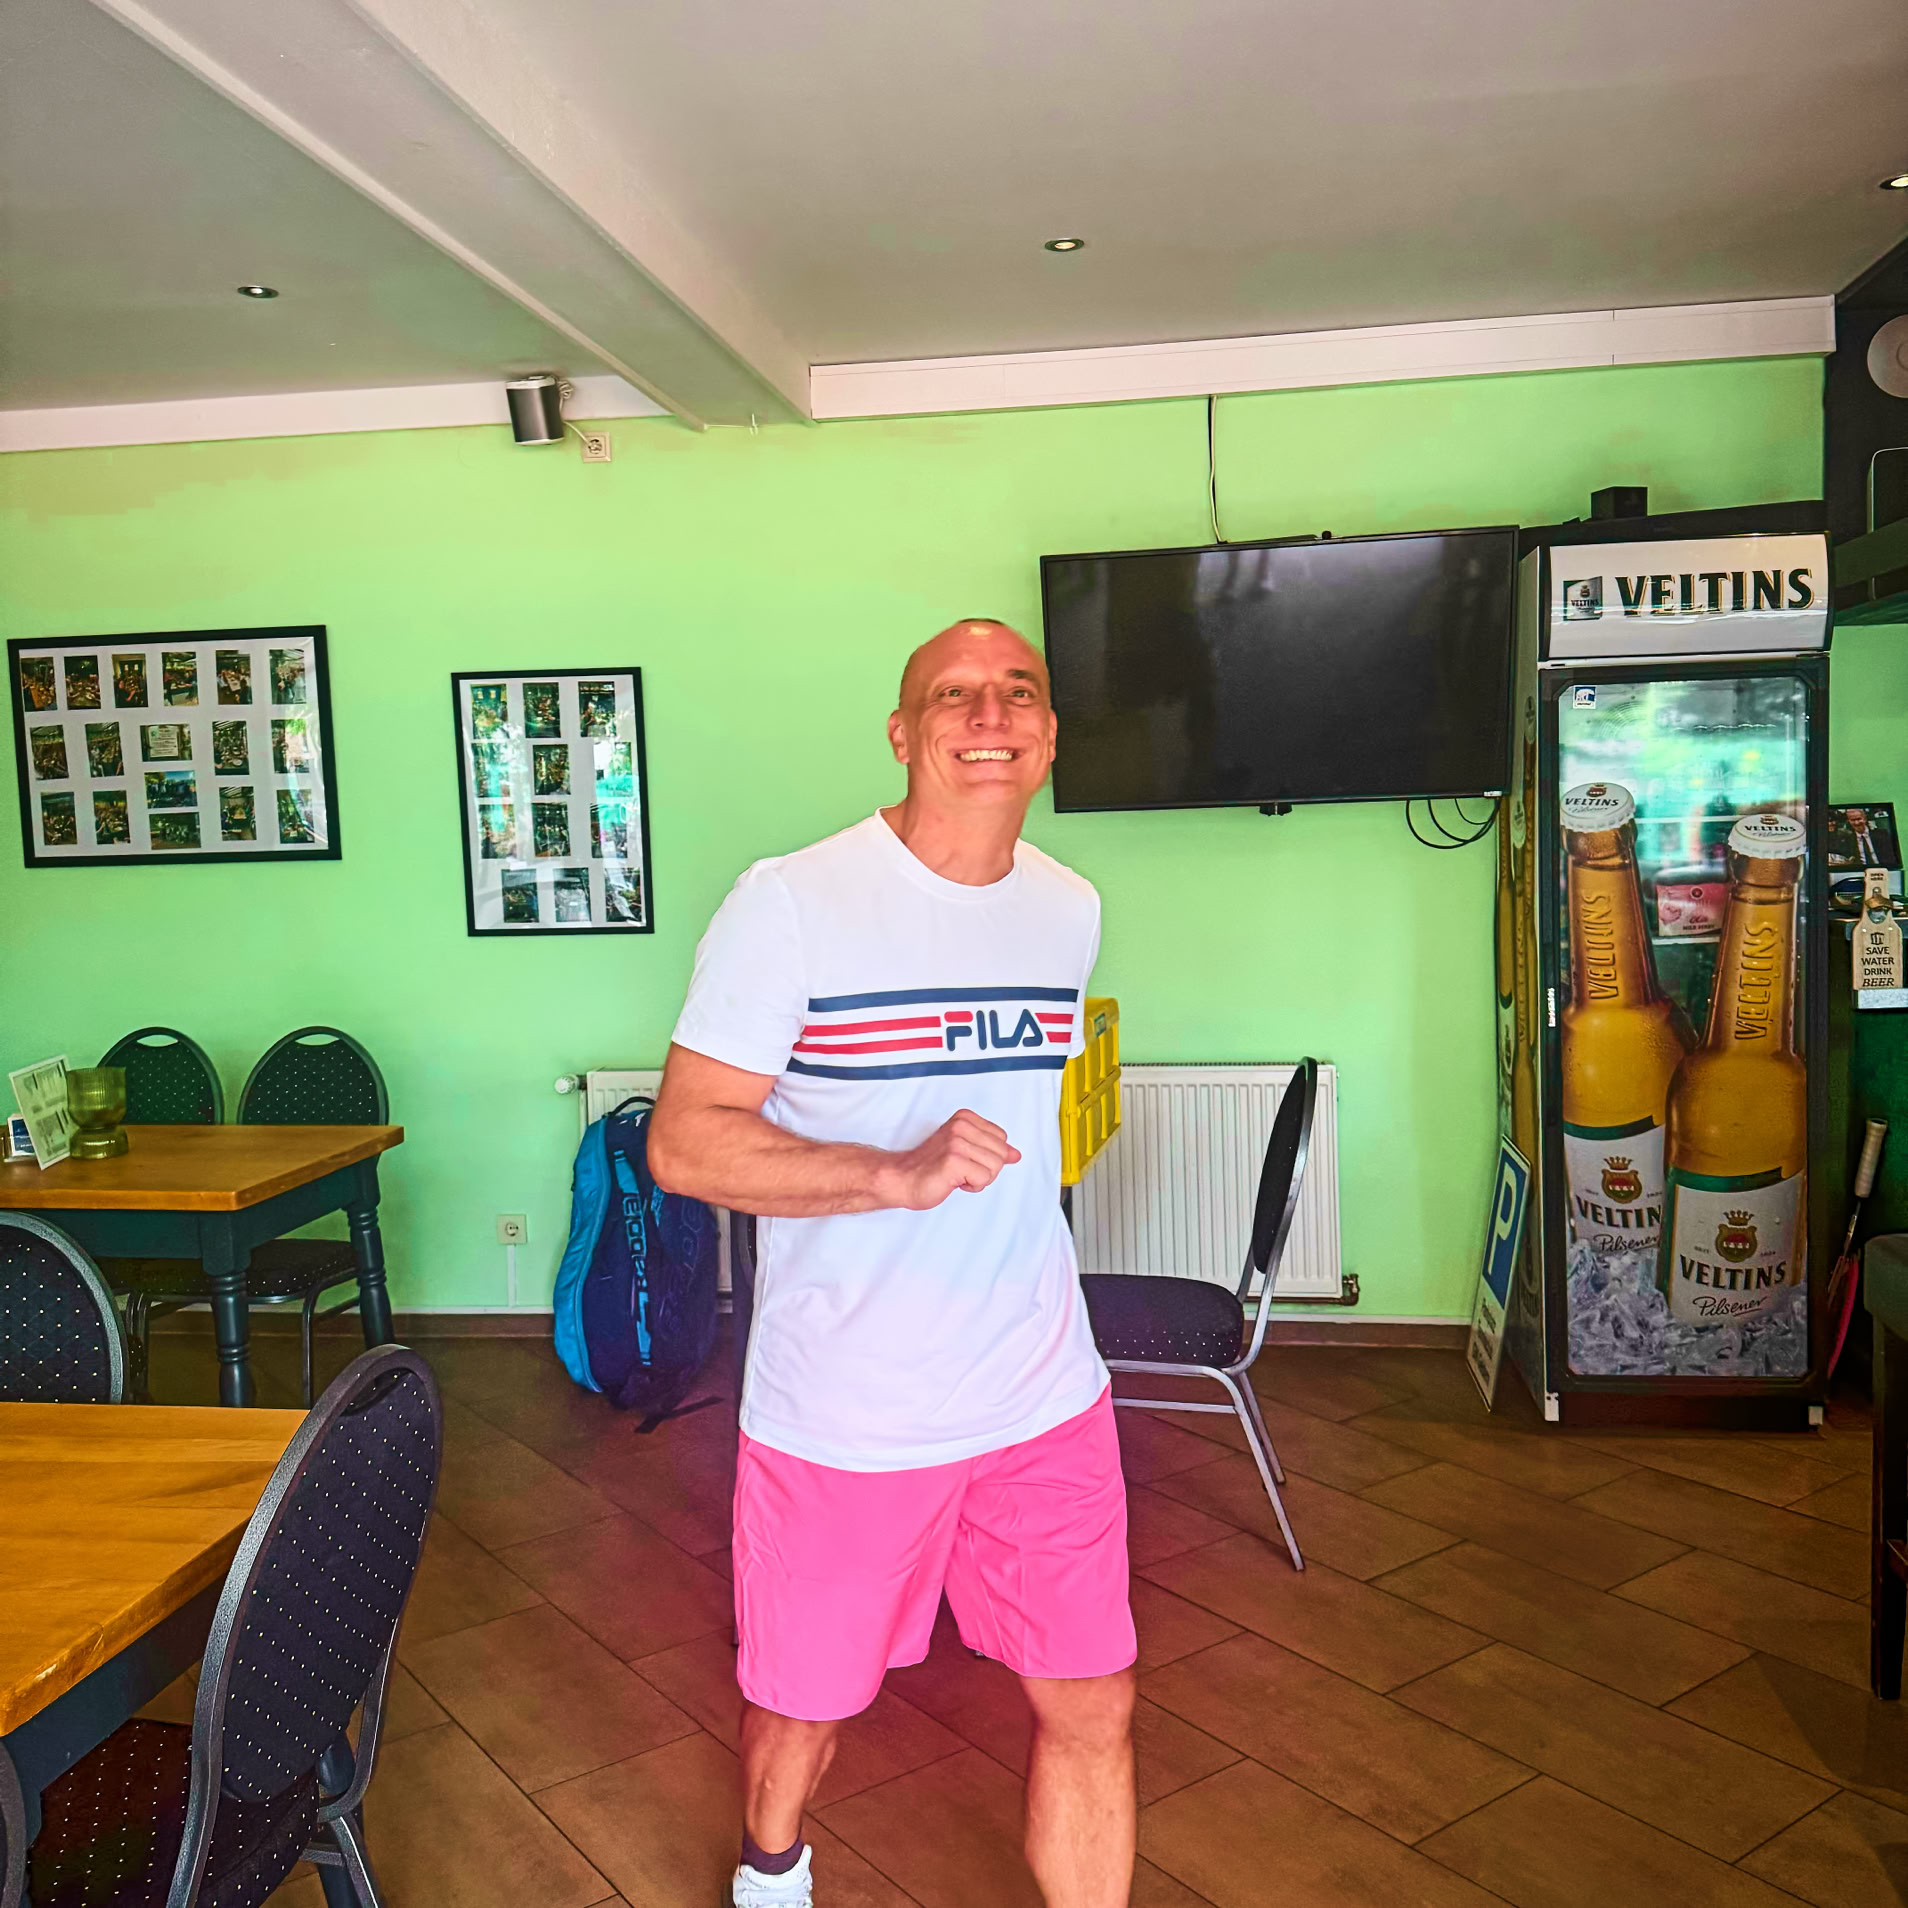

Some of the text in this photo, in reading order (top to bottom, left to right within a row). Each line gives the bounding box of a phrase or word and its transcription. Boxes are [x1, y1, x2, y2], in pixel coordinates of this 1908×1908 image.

[1615, 568, 1815, 617] VELTINS
[1565, 798, 1620, 807] VELTINS
[1581, 892, 1619, 999] VELTINS
[1865, 947, 1890, 955] SAVE
[1861, 957, 1895, 966] WATER
[1864, 967, 1892, 976] DRINK
[1734, 922, 1778, 1040] VELTINS
[1862, 978, 1895, 988] BEER
[944, 1008, 1044, 1052] FILA
[1487, 1161, 1517, 1276] P
[1575, 1194, 1662, 1229] VELTIN
[1592, 1233, 1658, 1253] Pilsener
[1680, 1254, 1787, 1291] VELTINS
[1692, 1295, 1768, 1317] Pilsener
